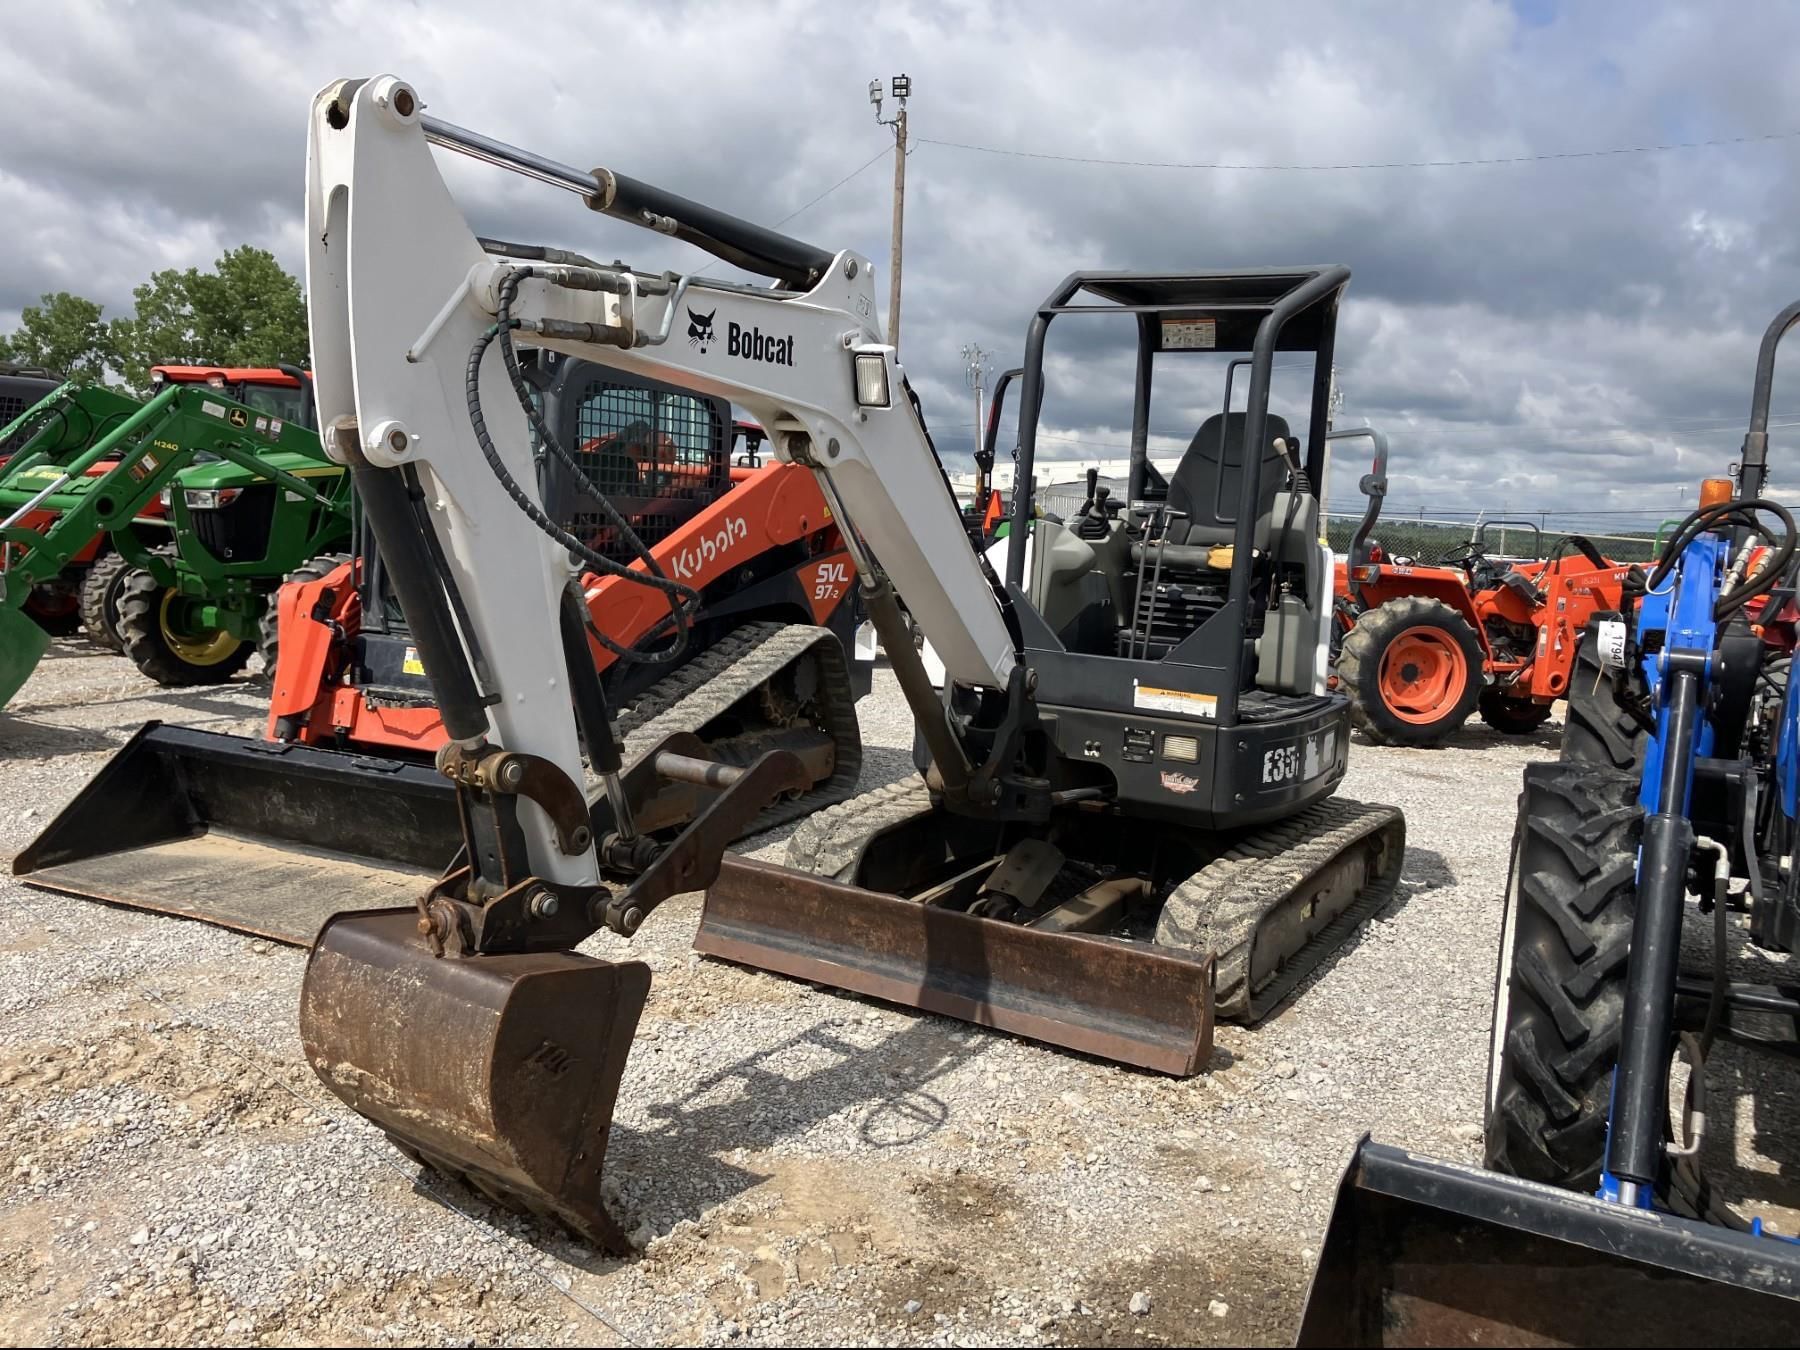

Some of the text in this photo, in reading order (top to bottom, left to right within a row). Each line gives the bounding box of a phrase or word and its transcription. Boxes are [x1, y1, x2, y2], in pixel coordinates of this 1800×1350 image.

[727, 321, 793, 367] Bobcat
[154, 440, 179, 451] H240
[672, 517, 748, 579] Kubota
[815, 563, 849, 583] SVL
[814, 584, 839, 600] 97-2
